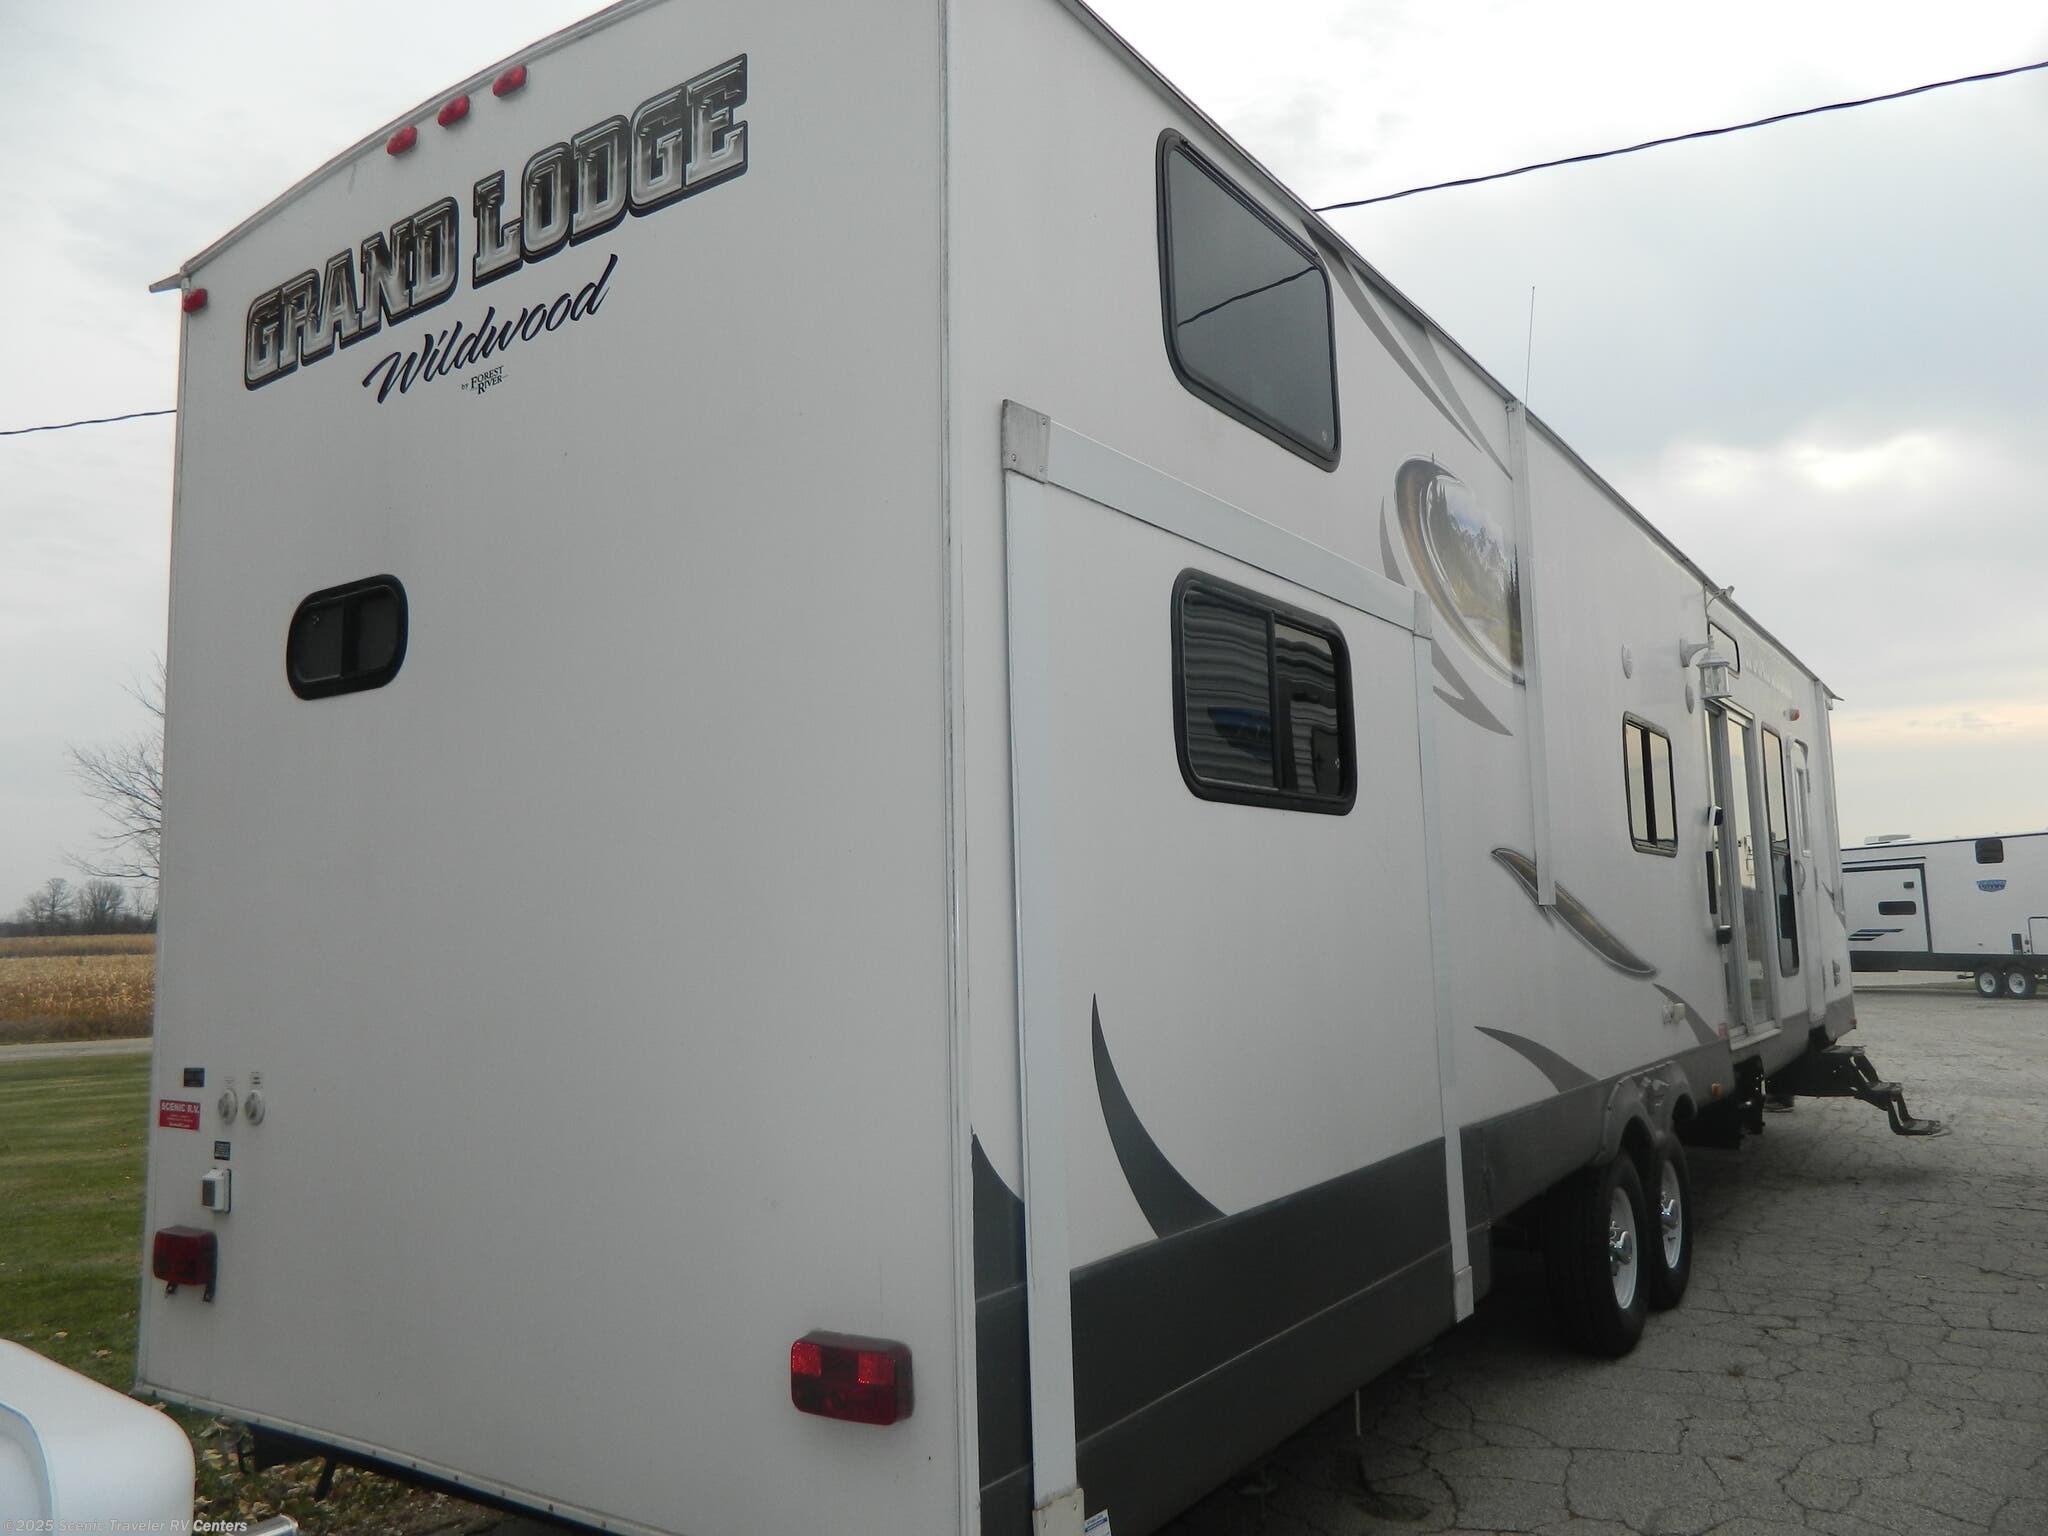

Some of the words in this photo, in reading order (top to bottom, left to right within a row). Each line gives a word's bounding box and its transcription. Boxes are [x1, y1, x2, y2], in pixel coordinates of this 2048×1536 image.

[244, 195, 460, 390] GRAND
[472, 53, 749, 290] LODGE
[362, 253, 619, 404] Wildwood
[471, 365, 504, 389] FOREST
[477, 375, 503, 395] RIVER
